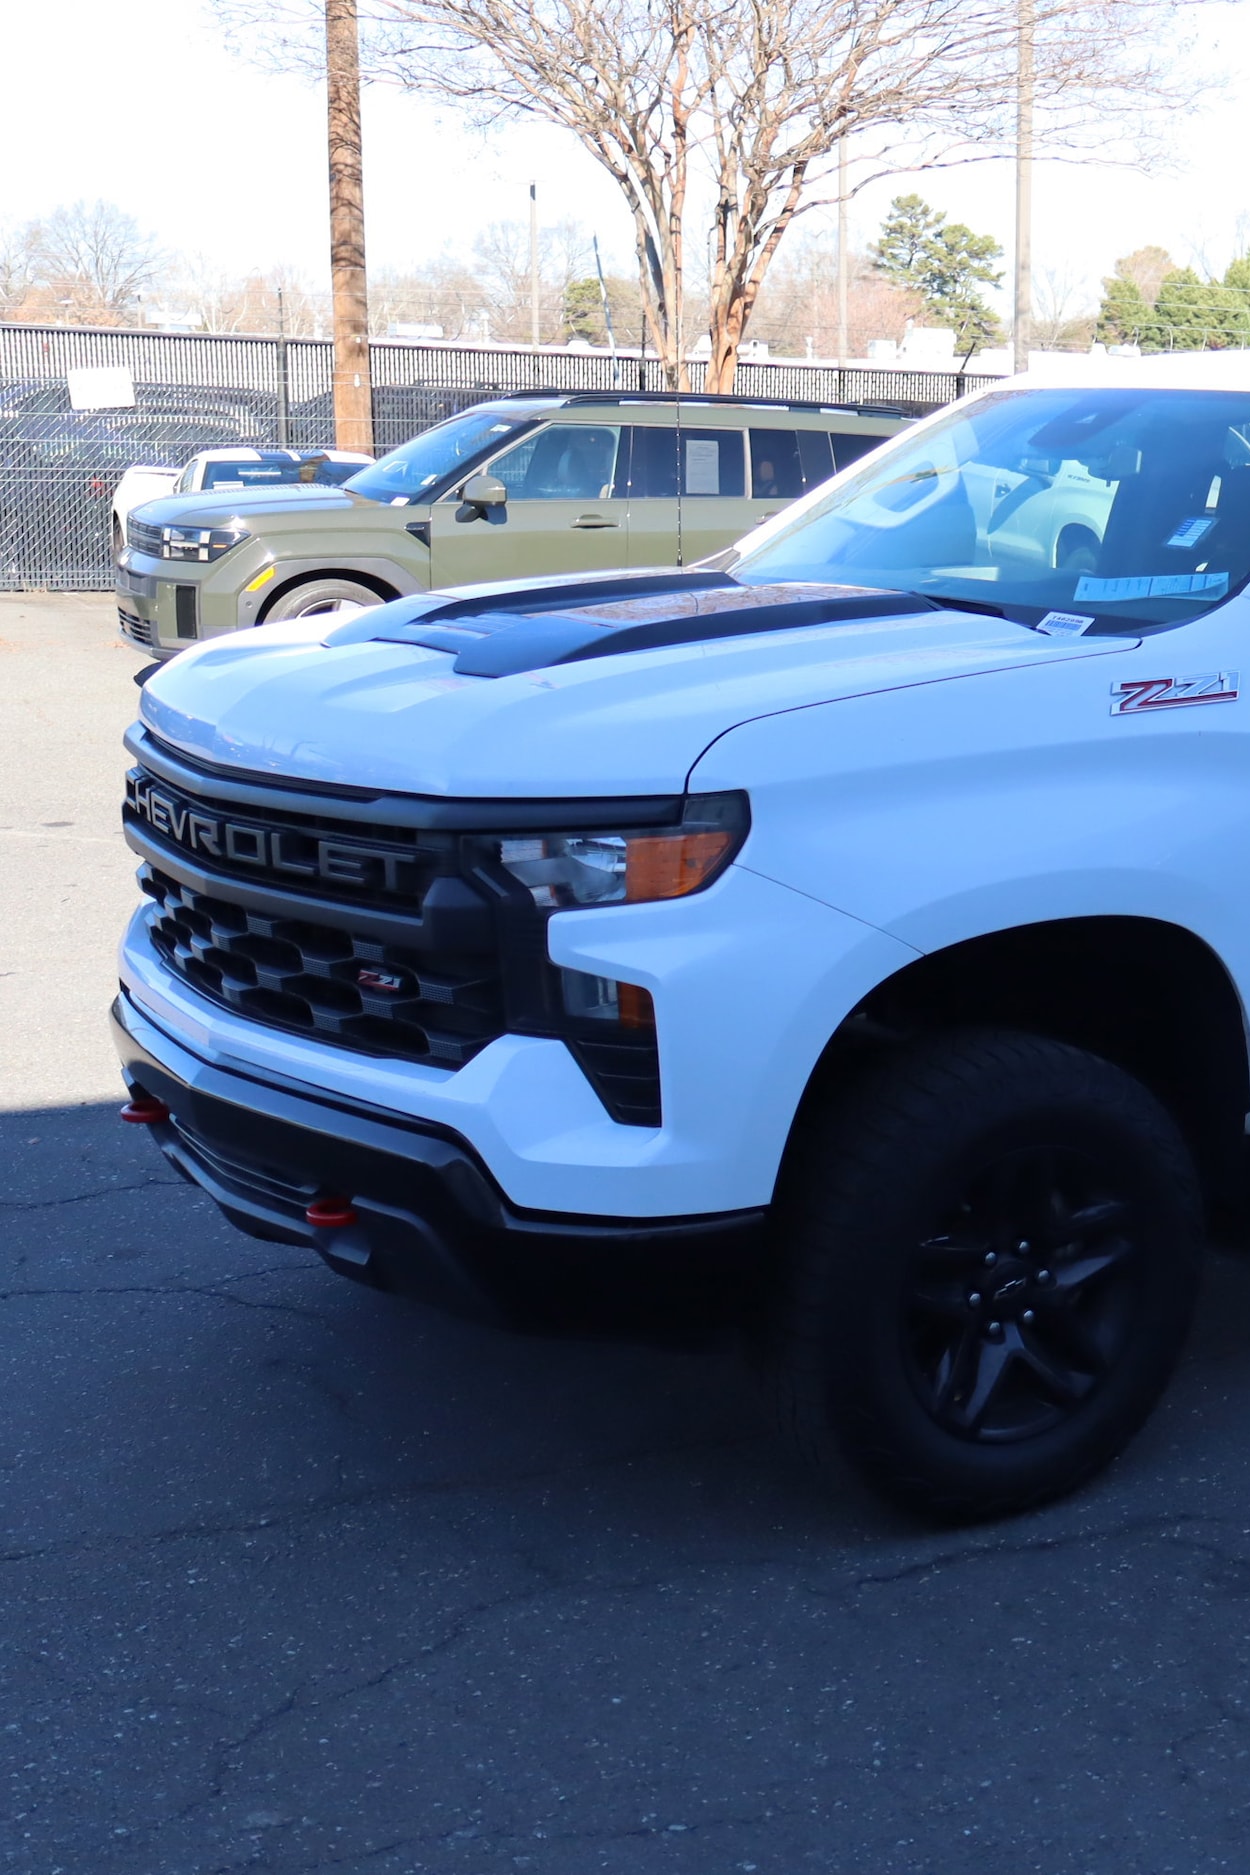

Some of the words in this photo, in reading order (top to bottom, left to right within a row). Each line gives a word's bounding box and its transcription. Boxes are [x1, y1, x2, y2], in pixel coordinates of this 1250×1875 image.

[1109, 669, 1240, 716] Z71
[125, 767, 417, 891] CHEVROLET
[358, 969, 401, 991] Z71
